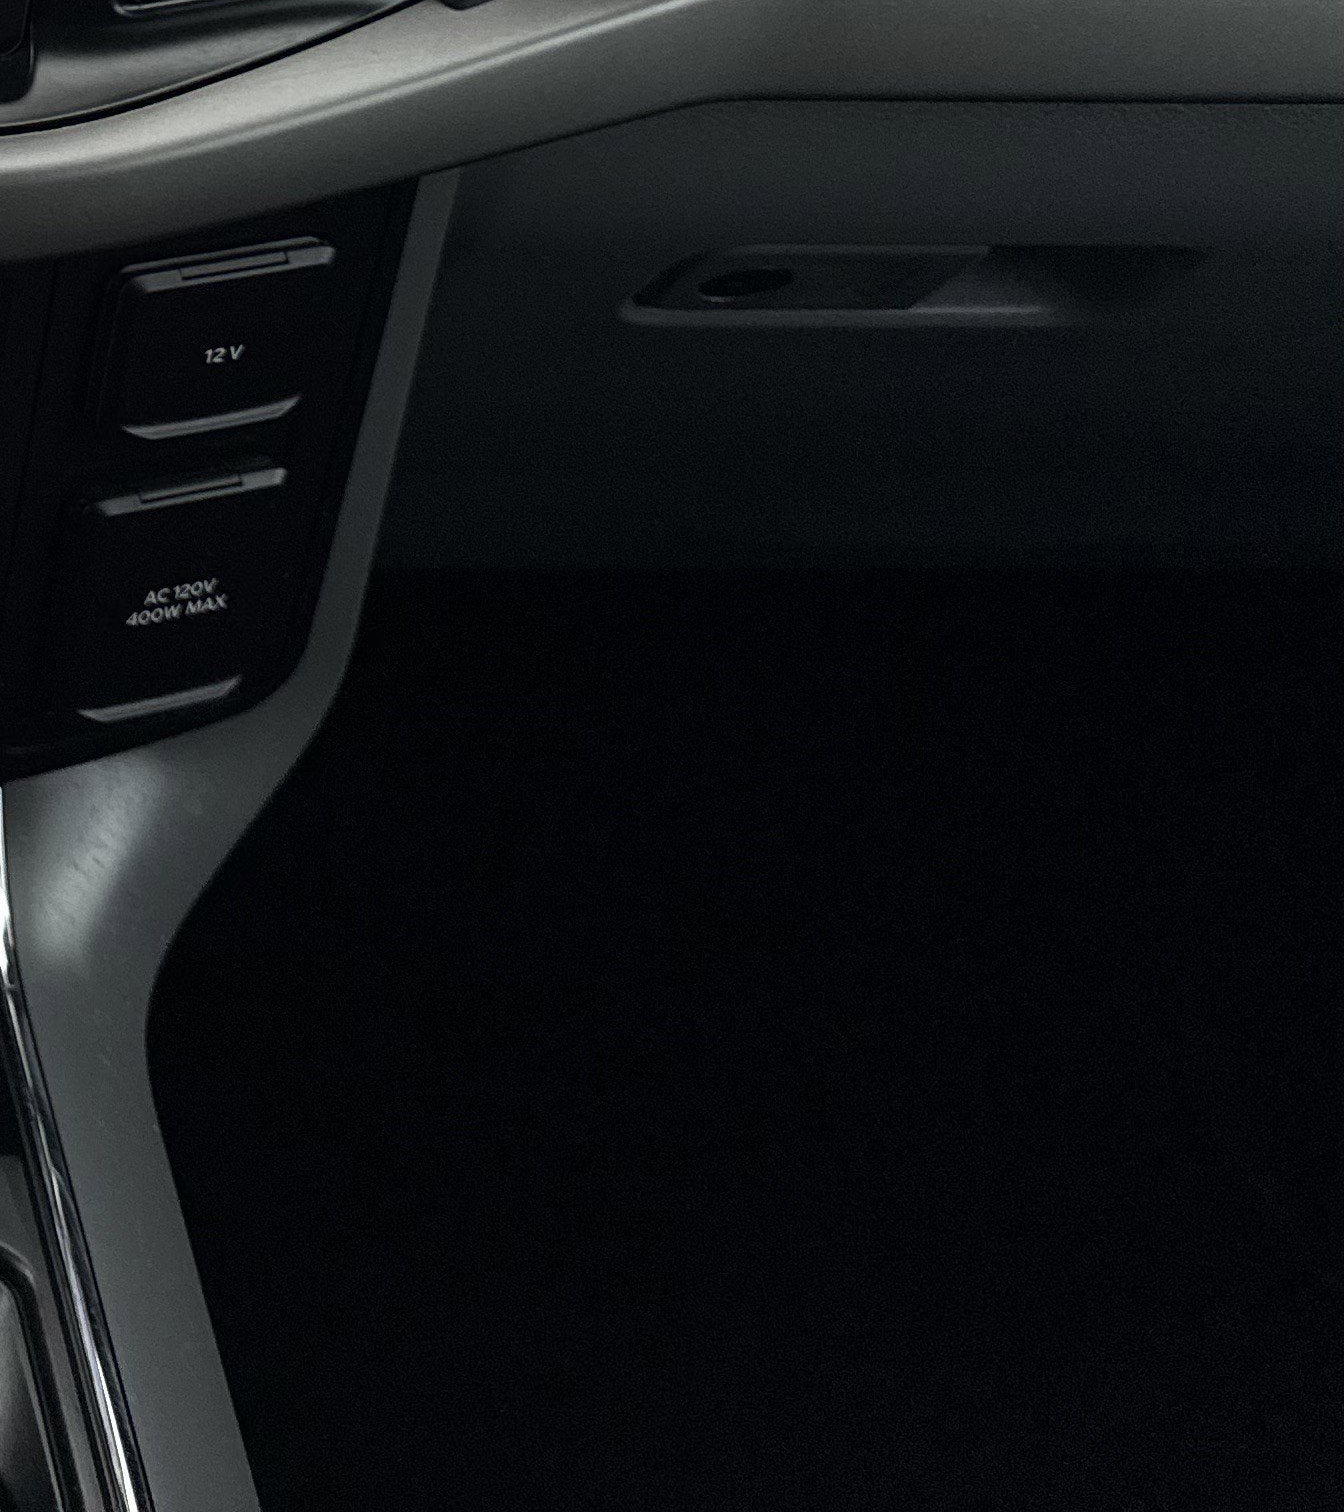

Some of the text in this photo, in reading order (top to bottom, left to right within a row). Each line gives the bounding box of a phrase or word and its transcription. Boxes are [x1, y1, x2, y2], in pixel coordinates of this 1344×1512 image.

[143, 577, 220, 606] AC 120V
[125, 593, 229, 626] 400W MAX
